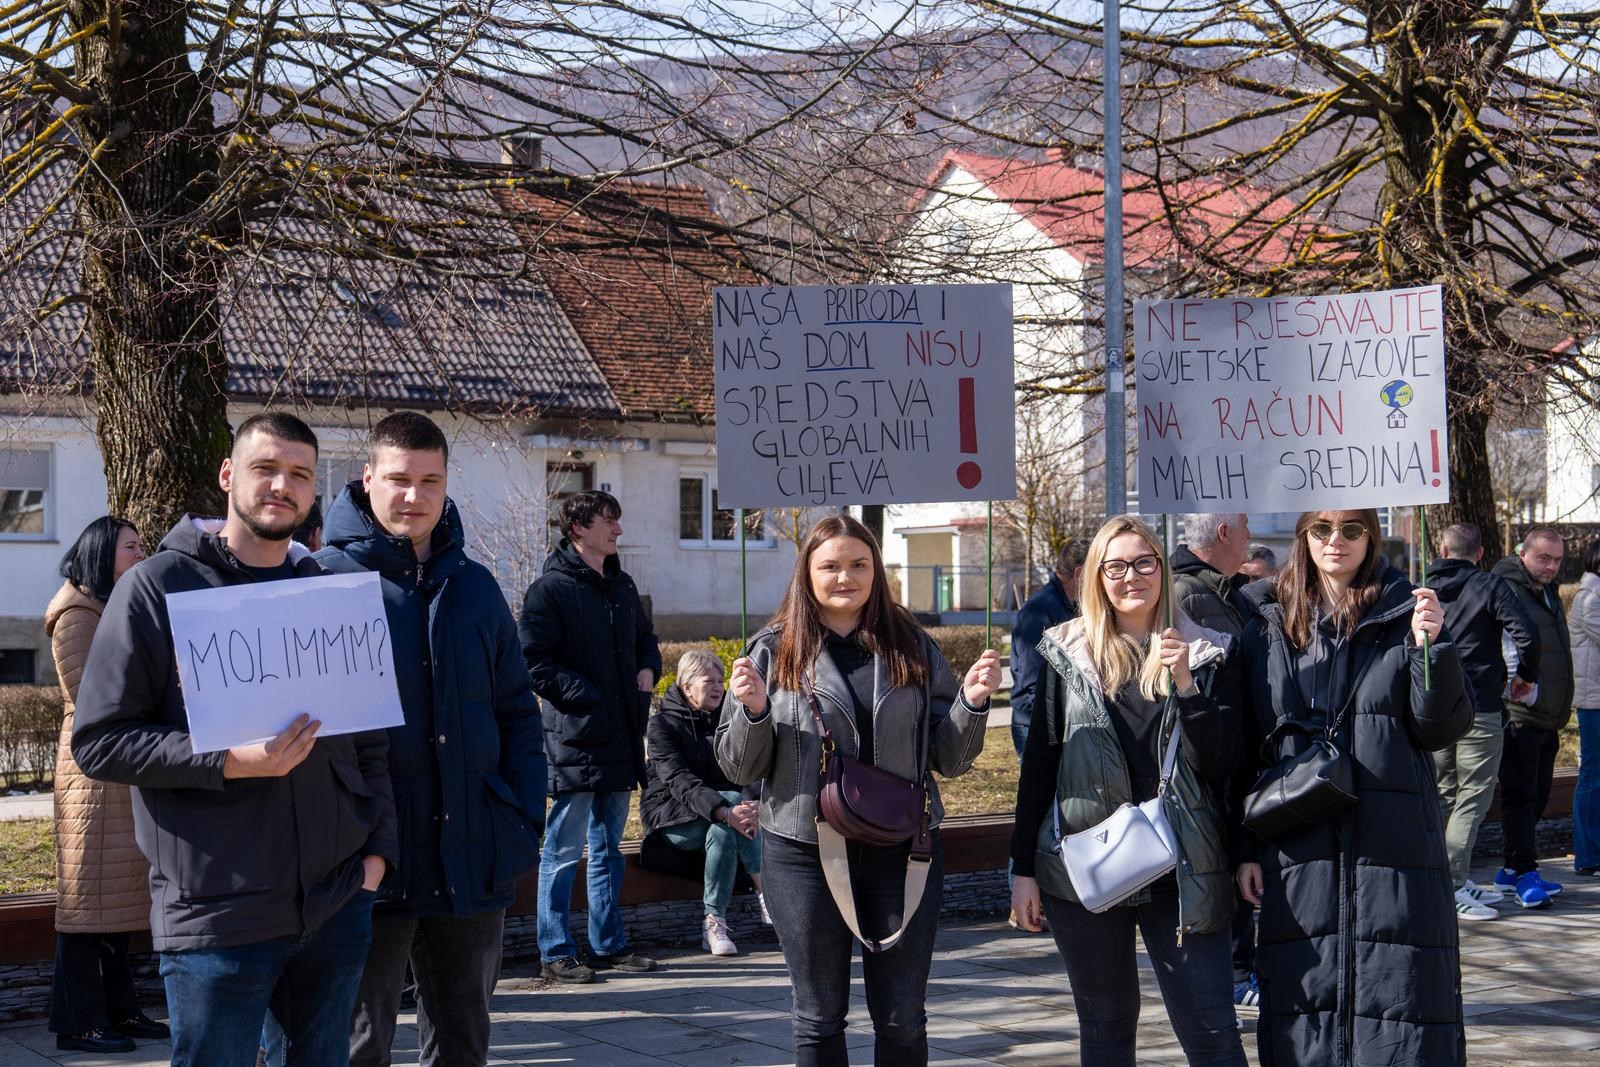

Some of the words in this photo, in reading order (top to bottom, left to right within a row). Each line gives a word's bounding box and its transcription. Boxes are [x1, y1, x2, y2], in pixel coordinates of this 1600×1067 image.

[716, 286, 802, 327] NAŠA
[824, 287, 921, 323] PRIRODA
[941, 289, 946, 321] I
[1147, 302, 1204, 342] NE
[1232, 289, 1438, 341] RJEŠAVAJTE
[722, 329, 781, 371] NAŠ
[803, 331, 871, 369] DOM
[906, 330, 981, 368] NISU
[1141, 346, 1272, 385] SVJETSKE
[1308, 335, 1431, 382] IZAZOVE
[723, 377, 934, 425] SREDSTVA
[1144, 400, 1182, 440] NA
[1212, 386, 1344, 440] RAČUN
[752, 419, 930, 467] GLOBALNIH
[777, 458, 894, 505] CILJEVA
[1152, 454, 1249, 500] MALIH
[188, 618, 387, 692] MOLIMMM?
